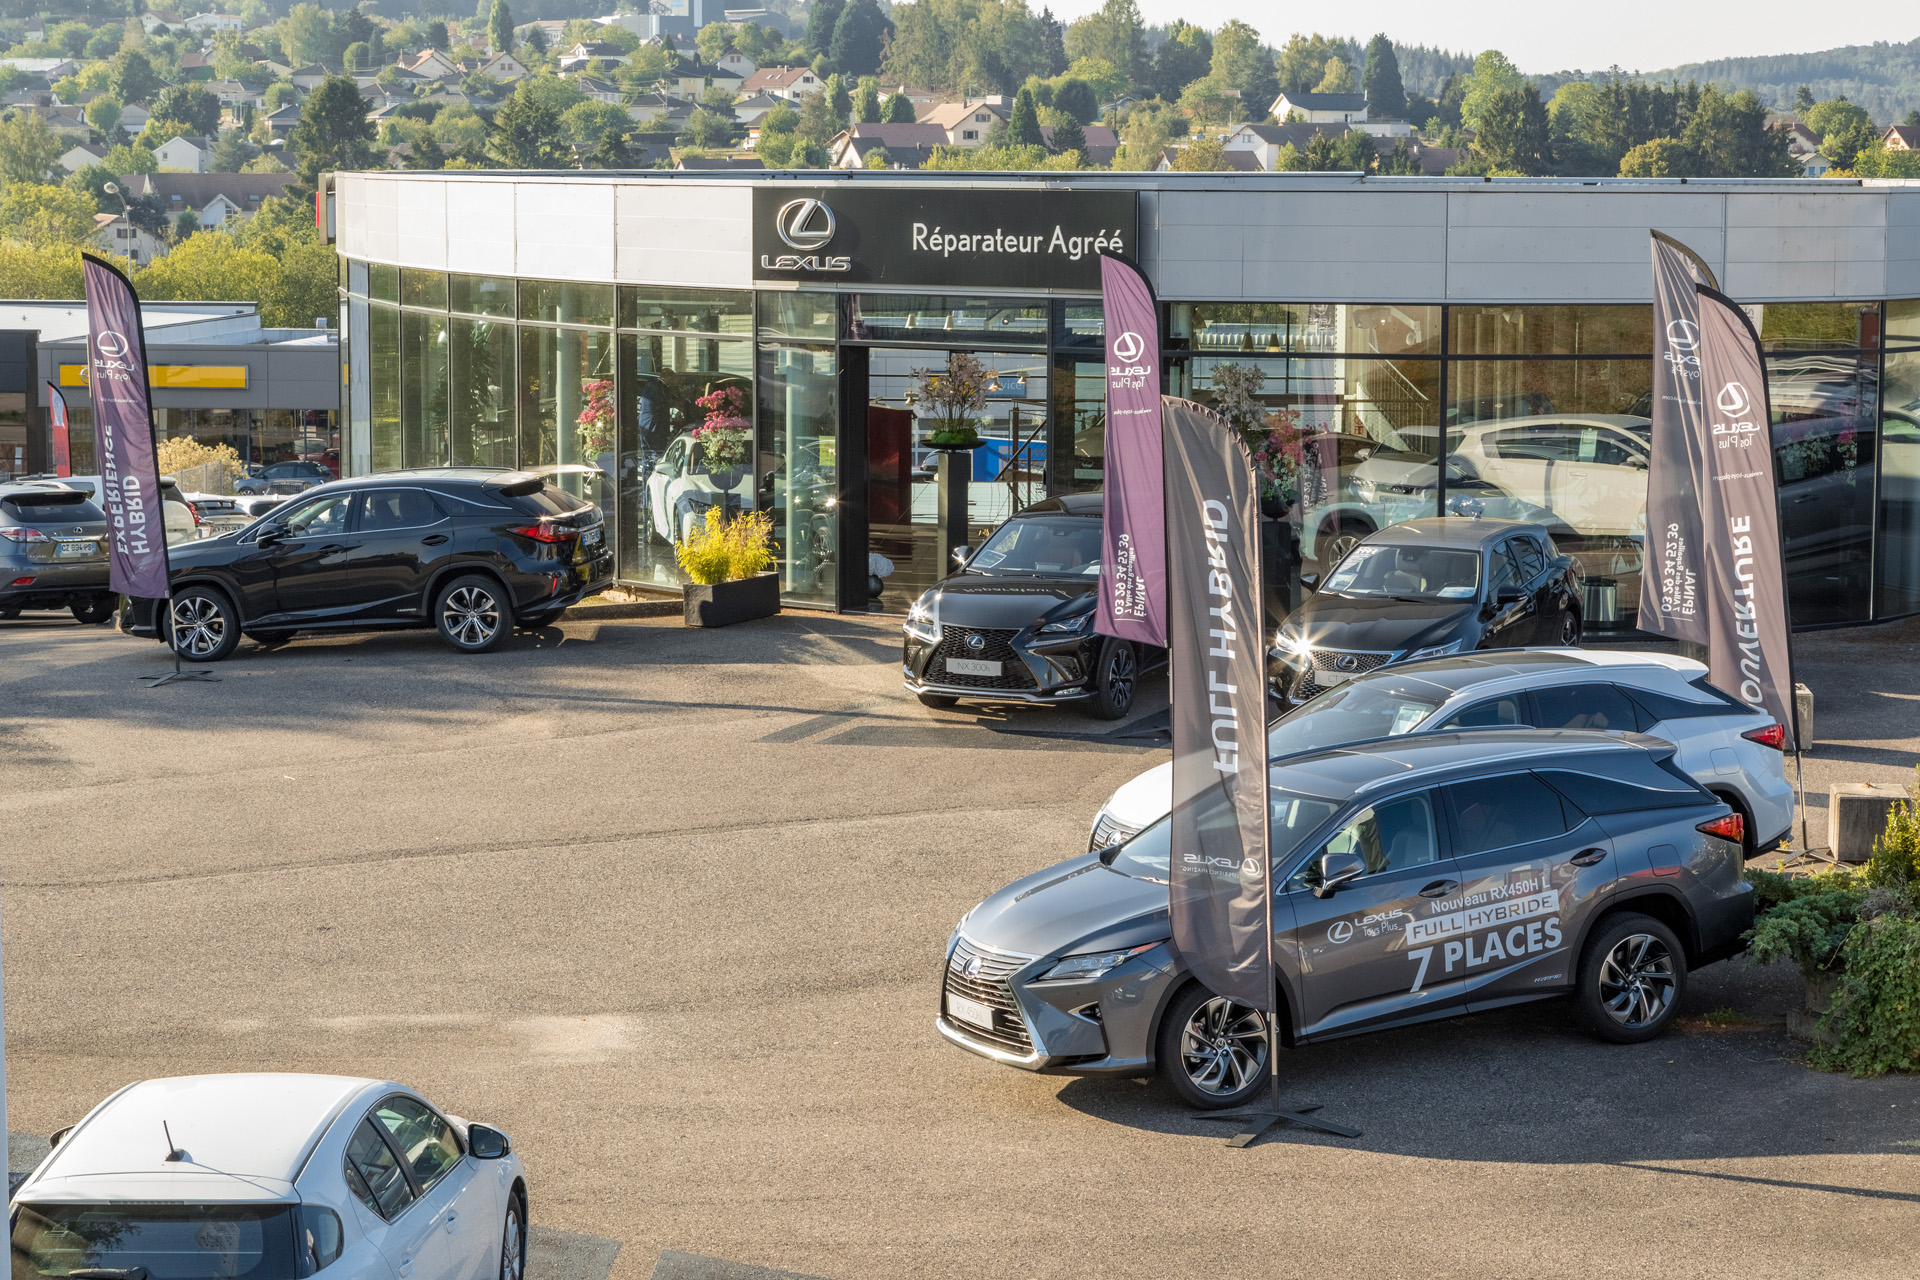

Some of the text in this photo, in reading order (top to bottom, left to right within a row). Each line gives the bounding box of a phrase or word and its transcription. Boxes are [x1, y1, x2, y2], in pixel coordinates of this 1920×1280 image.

[913, 222, 1124, 261] Réparateur Agréé
[761, 254, 851, 272] LEXUS
[957, 662, 970, 670] NX
[1431, 876, 1550, 914] Nouveau RX450H L
[1355, 908, 1403, 927] LEXUS
[1381, 922, 1398, 934] Plus
[1413, 896, 1553, 940] FULL HYBRIDE
[1408, 917, 1562, 993] 7 PLACES
